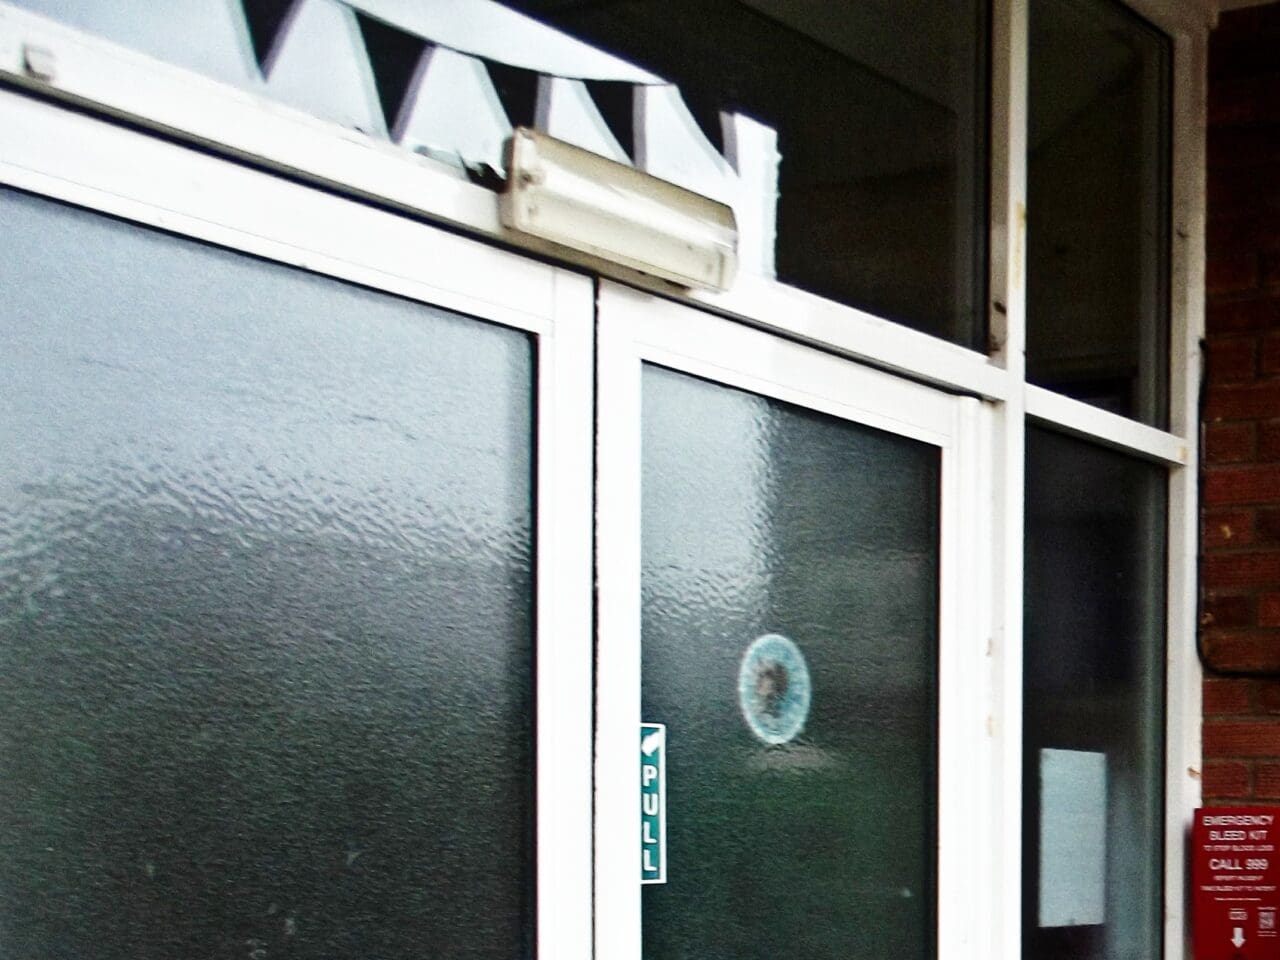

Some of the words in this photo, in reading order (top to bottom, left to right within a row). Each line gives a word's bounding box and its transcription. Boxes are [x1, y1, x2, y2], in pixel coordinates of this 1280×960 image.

[643, 767, 658, 871] PULL
[1203, 815, 1274, 826] EMERGENCY
[1209, 830, 1246, 841] BLEED
[1249, 830, 1268, 841] KIT
[1209, 859, 1243, 870] CALL
[1245, 859, 1269, 870] 999
